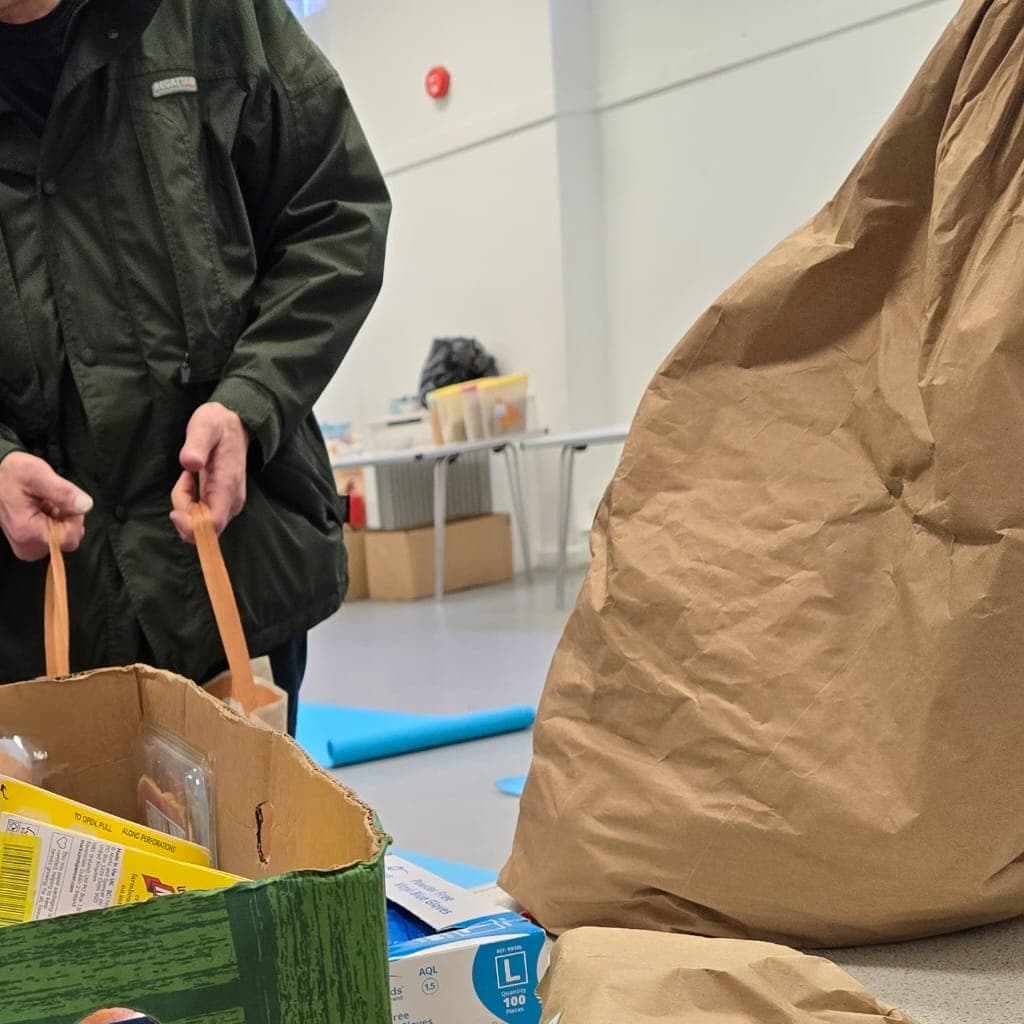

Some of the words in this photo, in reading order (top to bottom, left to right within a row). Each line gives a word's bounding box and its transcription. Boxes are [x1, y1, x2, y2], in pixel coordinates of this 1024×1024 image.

[75, 812, 82, 821] TO
[98, 820, 112, 833] PULL
[122, 827, 139, 841] ALONG
[139, 832, 176, 853] PERFORATIONS
[419, 966, 438, 977] AQL
[503, 958, 521, 982] L
[424, 982, 436, 991] 1.5
[501, 988, 527, 997] Quantity
[503, 995, 526, 1008] 100
[393, 1011, 410, 1021] ree
[506, 1007, 525, 1015] Pieces
